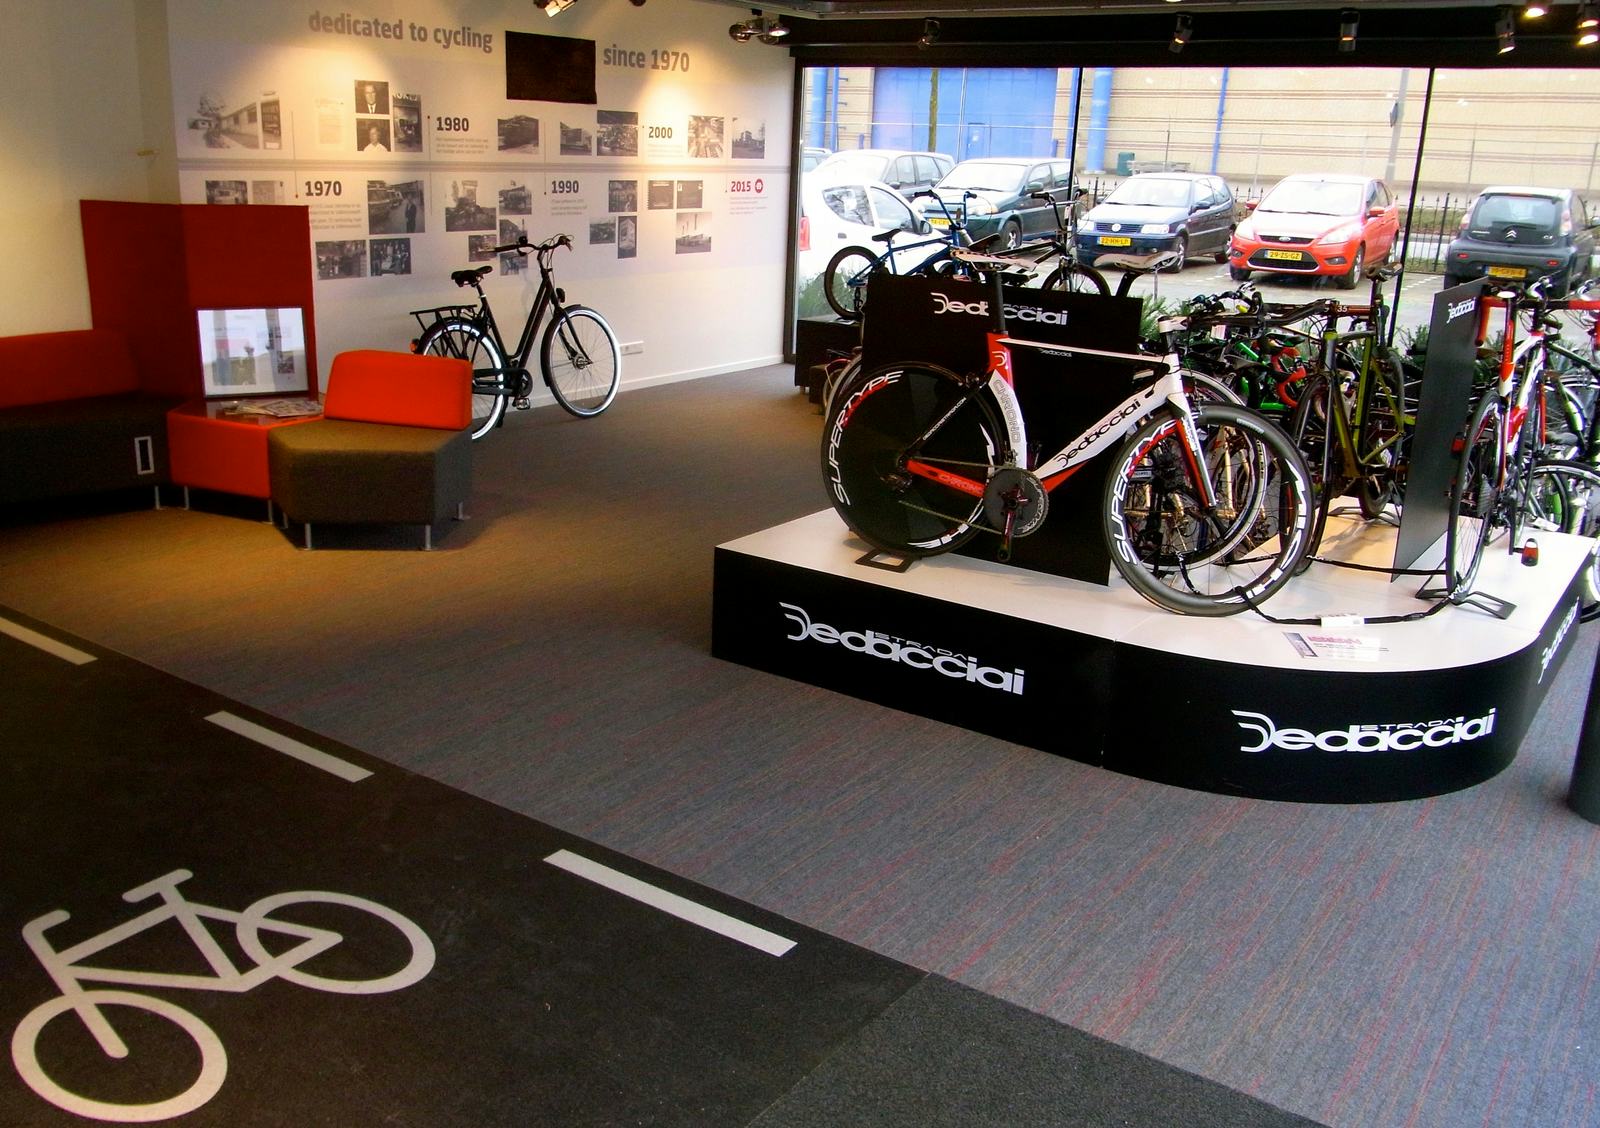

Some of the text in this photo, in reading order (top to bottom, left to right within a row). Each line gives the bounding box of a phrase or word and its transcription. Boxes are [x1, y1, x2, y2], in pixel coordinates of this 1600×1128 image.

[308, 11, 493, 53] dedicated to cycling
[603, 44, 690, 72] since 1970
[436, 116, 470, 132] 1980
[648, 126, 673, 139] 2000
[304, 180, 342, 196] 1970
[551, 180, 580, 194] 1990
[730, 180, 751, 193] 2015
[930, 291, 1068, 326] Dedcciai
[993, 379, 1021, 444] CHRONO
[828, 370, 904, 506] SUPERTYPE
[1054, 399, 1141, 468] Dedacciai
[779, 601, 1025, 696] Dedacciai
[1231, 708, 1497, 753] Dedacciai
